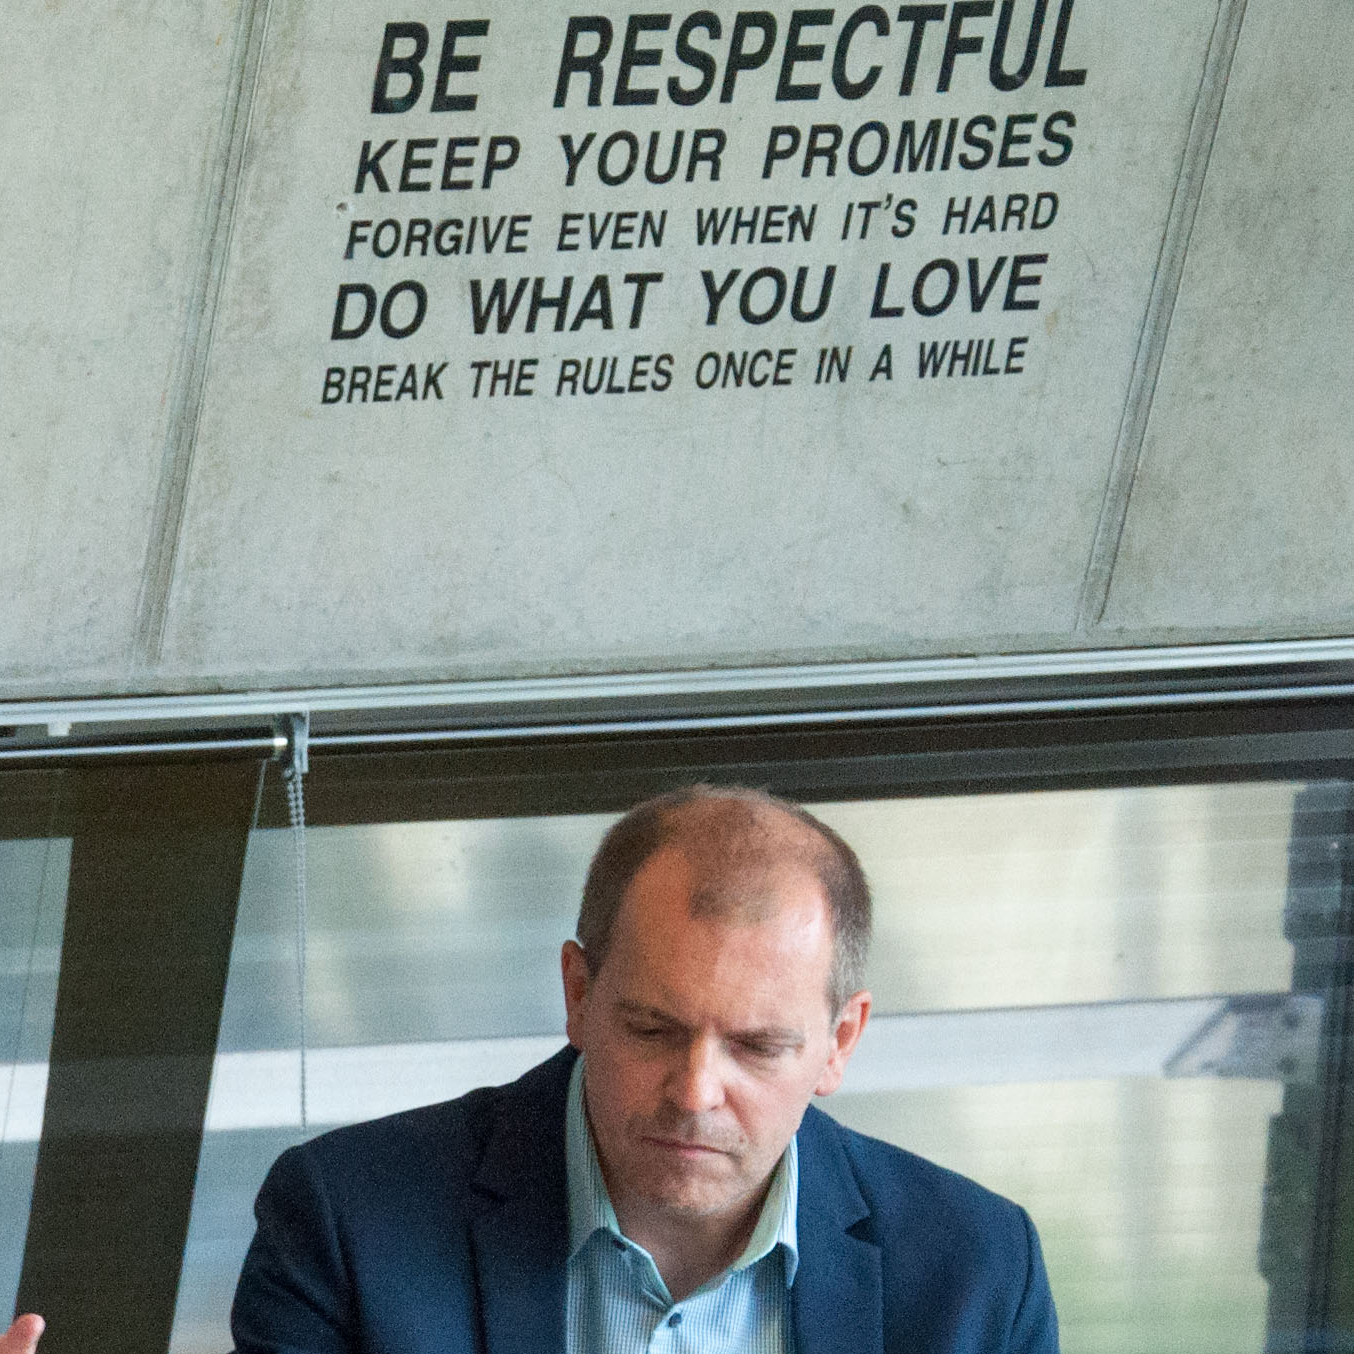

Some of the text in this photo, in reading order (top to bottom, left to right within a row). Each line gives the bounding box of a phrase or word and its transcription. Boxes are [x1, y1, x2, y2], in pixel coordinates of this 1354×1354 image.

[370, 0, 1088, 115] BE RESPECTFUL
[354, 110, 1076, 194] KEEP YOUR PROMISES
[344, 192, 1059, 260] FORGIVE EVEN WHEN IT'S HARD
[330, 253, 1049, 341] DO WHAT YOU LOVE
[321, 336, 1029, 405] BREAK THE RULES ONCE IN A WHILE
